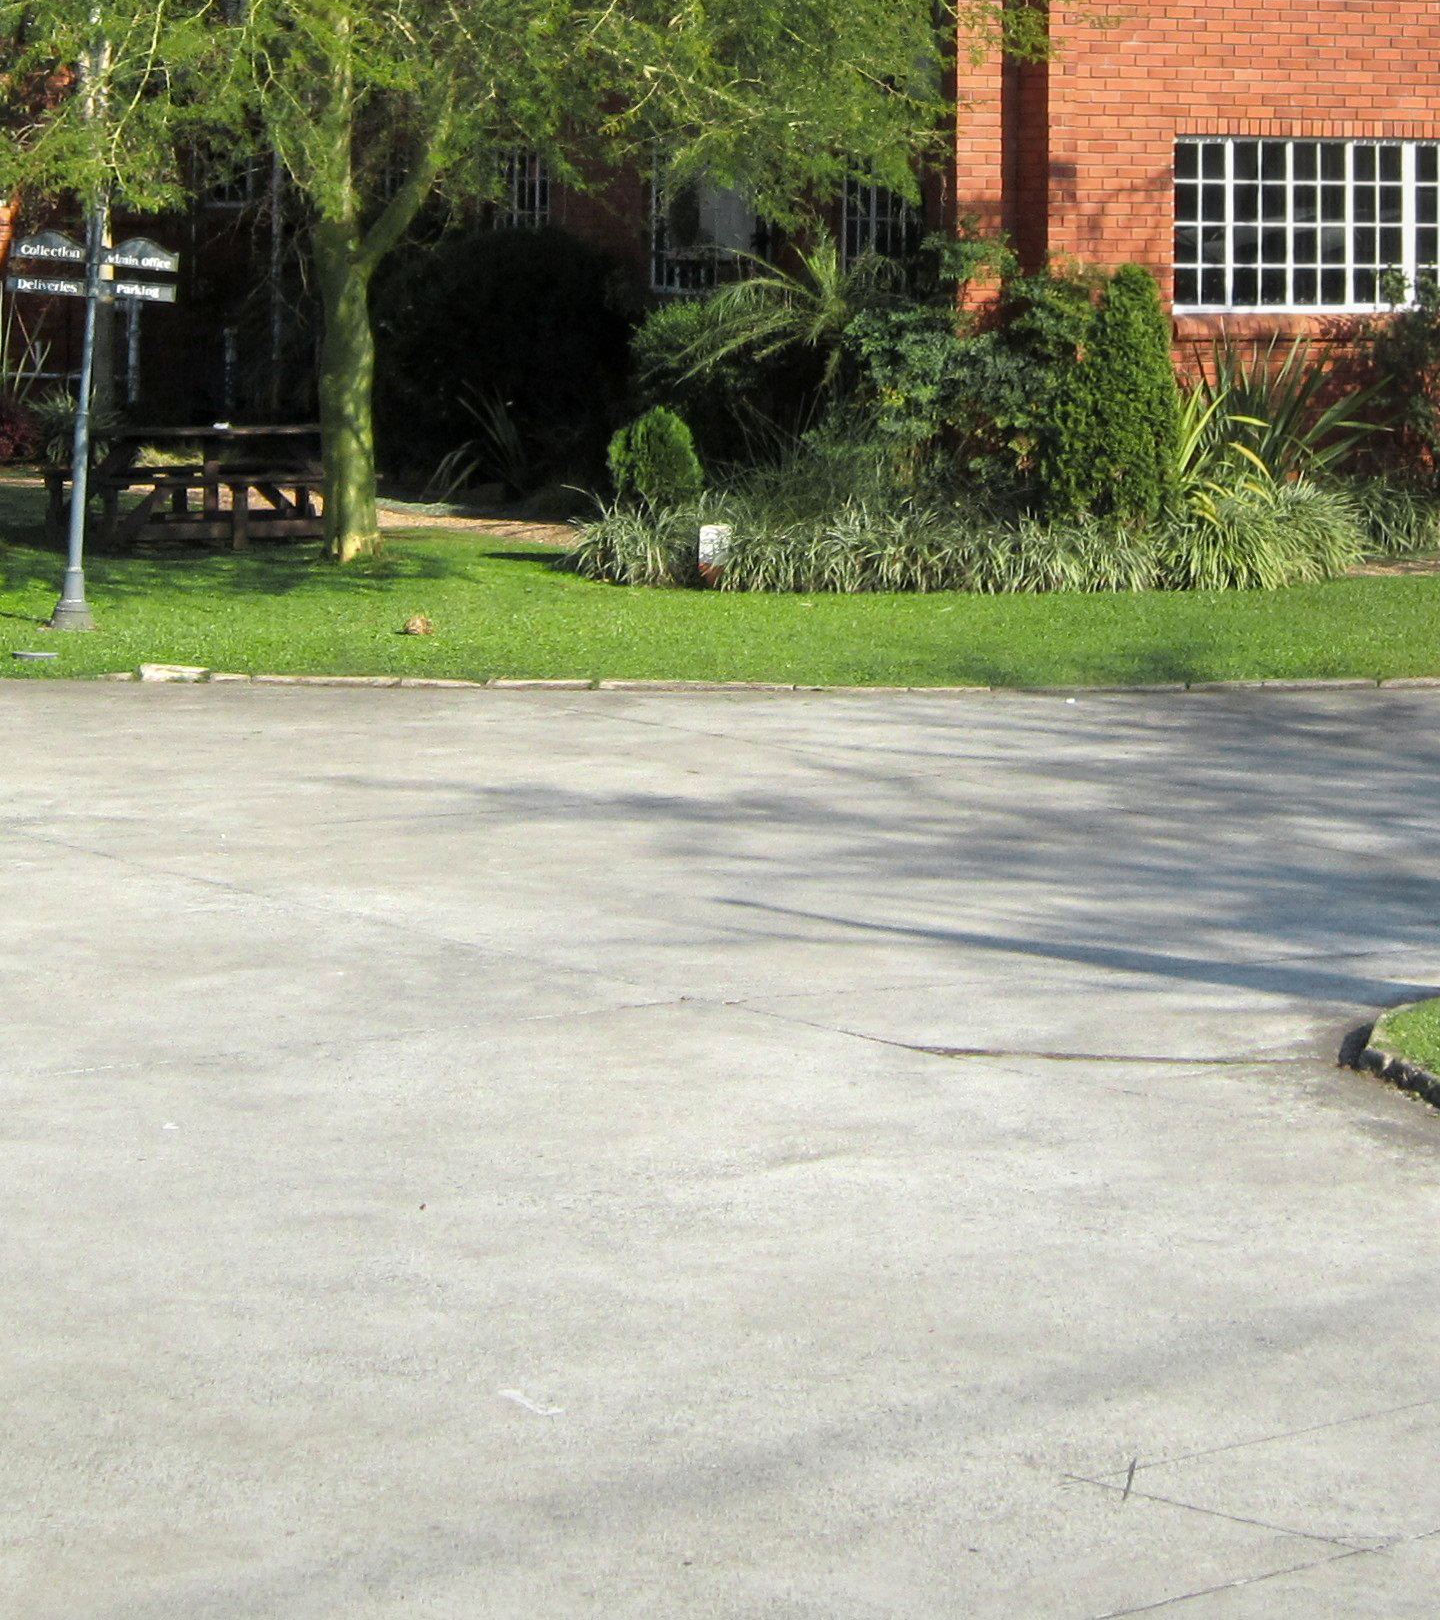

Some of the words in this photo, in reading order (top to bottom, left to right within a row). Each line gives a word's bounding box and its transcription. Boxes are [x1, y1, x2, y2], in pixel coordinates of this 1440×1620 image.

[20, 244, 81, 259] Collection
[104, 253, 139, 267] Admin
[141, 257, 172, 272] Office
[17, 278, 78, 293] Deliveries
[116, 284, 160, 299] Parking
